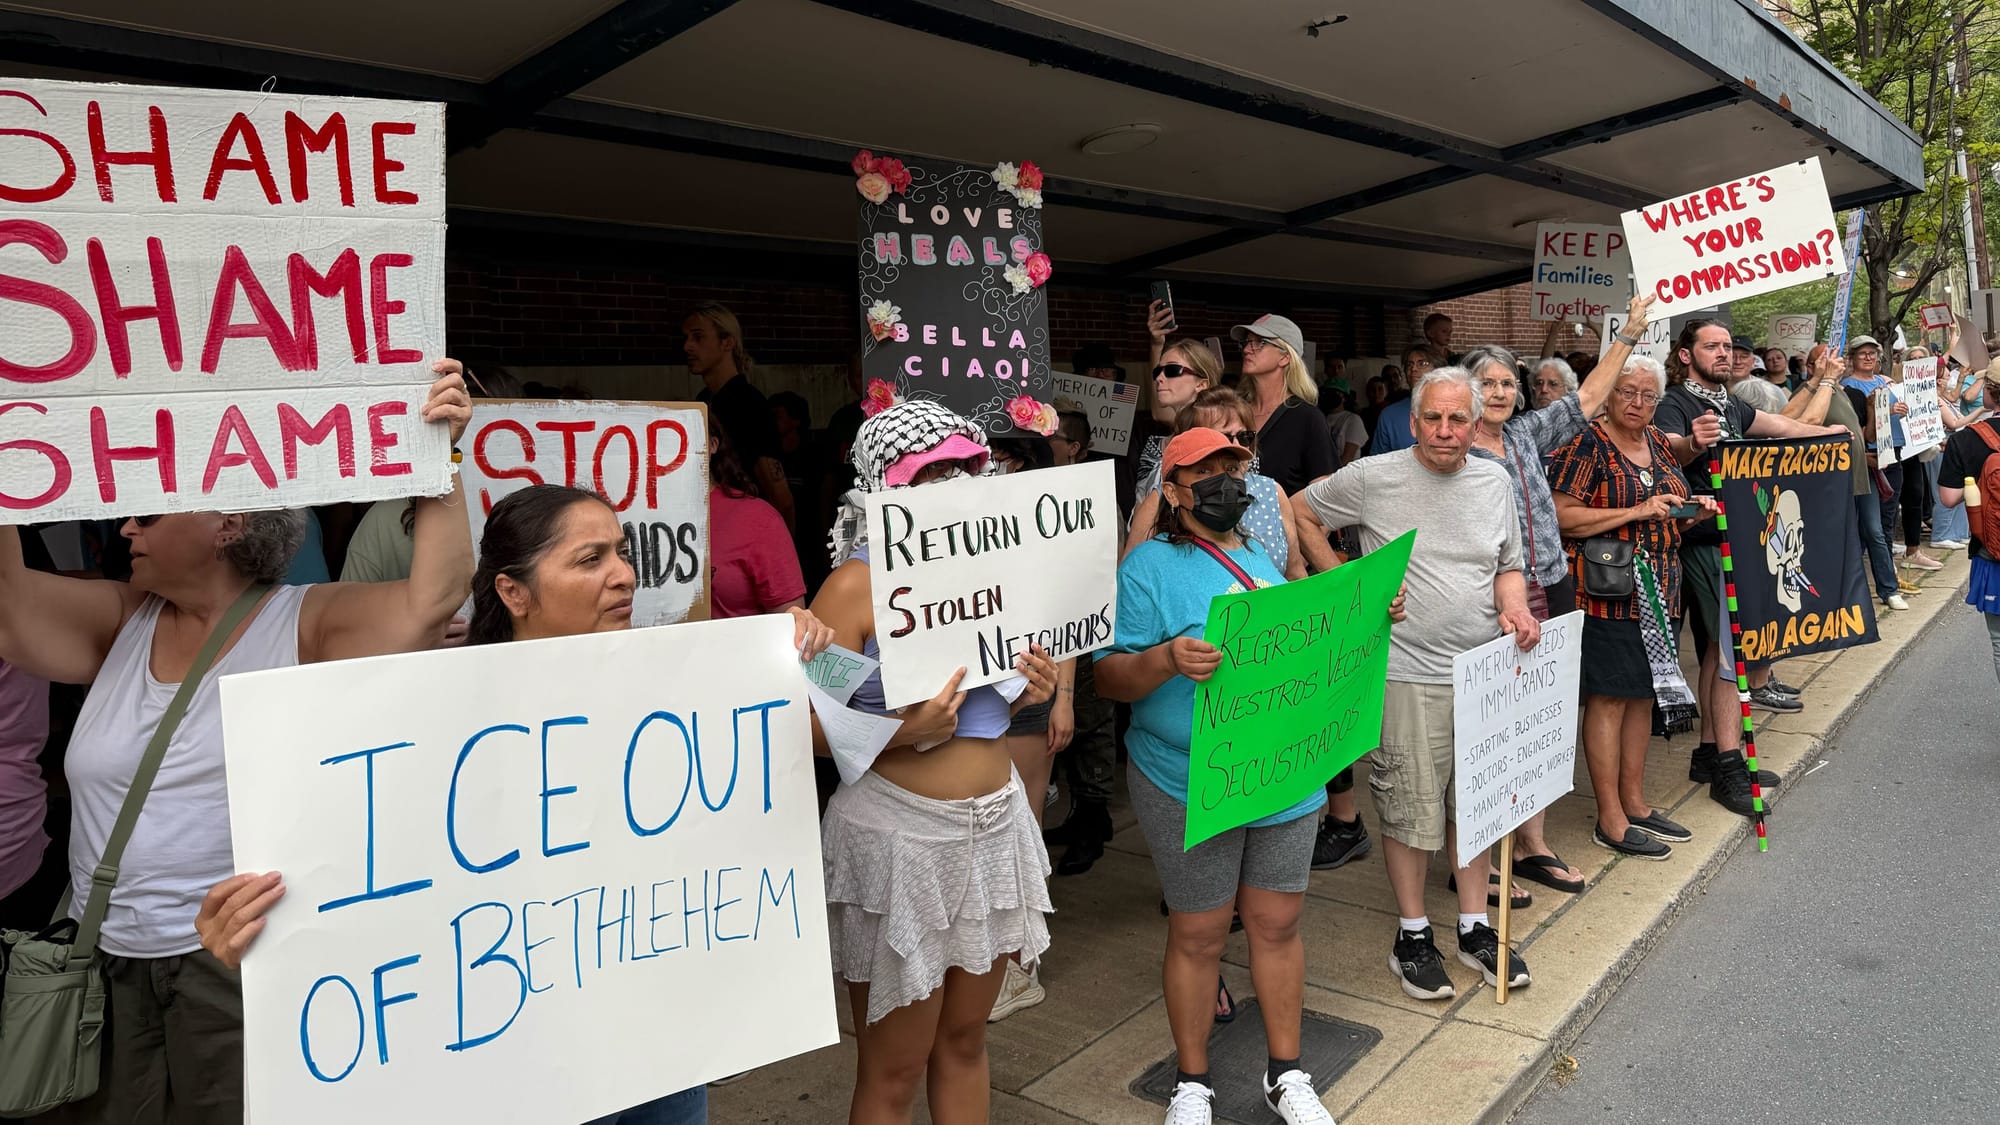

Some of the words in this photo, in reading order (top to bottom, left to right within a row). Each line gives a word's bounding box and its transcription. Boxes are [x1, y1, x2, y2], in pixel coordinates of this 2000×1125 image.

[0, 90, 418, 207] SHAME
[898, 203, 1013, 229] LOVE
[1643, 175, 1775, 233] WHERE'S
[874, 232, 1031, 266] HEALS
[1543, 231, 1624, 258] KEEP
[1682, 217, 1764, 258] YOUR
[1537, 262, 1614, 287] Families
[1656, 229, 1834, 304] COMPASSION?
[0, 219, 423, 383] SHAME
[1535, 292, 1611, 320] Together
[893, 323, 1026, 349] BELLA
[904, 355, 1029, 388] CIAO!
[1052, 377, 1107, 399] MERICA
[1090, 426, 1127, 443] ANTS
[1099, 405, 1119, 419] OF
[0, 401, 413, 510] SHAME
[473, 419, 688, 517] STOP
[1721, 446, 1779, 480] MAKE
[1778, 442, 1850, 476] RACISTS
[622, 521, 699, 589] AIDS
[881, 503, 1022, 572] RETURN
[1035, 493, 1096, 539] OUR
[888, 584, 1004, 638] STOLEN
[1219, 600, 1335, 671] REGRSEN
[1346, 579, 1362, 624] A
[1782, 604, 1865, 649] AGAIN
[978, 603, 1111, 676] NEIGHBORS
[1463, 643, 1519, 695] AMERICA
[1480, 660, 1557, 723] IMMIGRANTS
[1200, 671, 1319, 735] NUESTROS
[1514, 700, 1563, 737] BUSINESSES
[624, 699, 791, 837] OUT
[1201, 696, 1361, 811] SECUSTRADOS
[1517, 727, 1562, 764] ENGINEERS
[1510, 794, 1535, 821] TAXES
[300, 954, 421, 1083] OF
[445, 867, 802, 1052] BETHLEHEM
